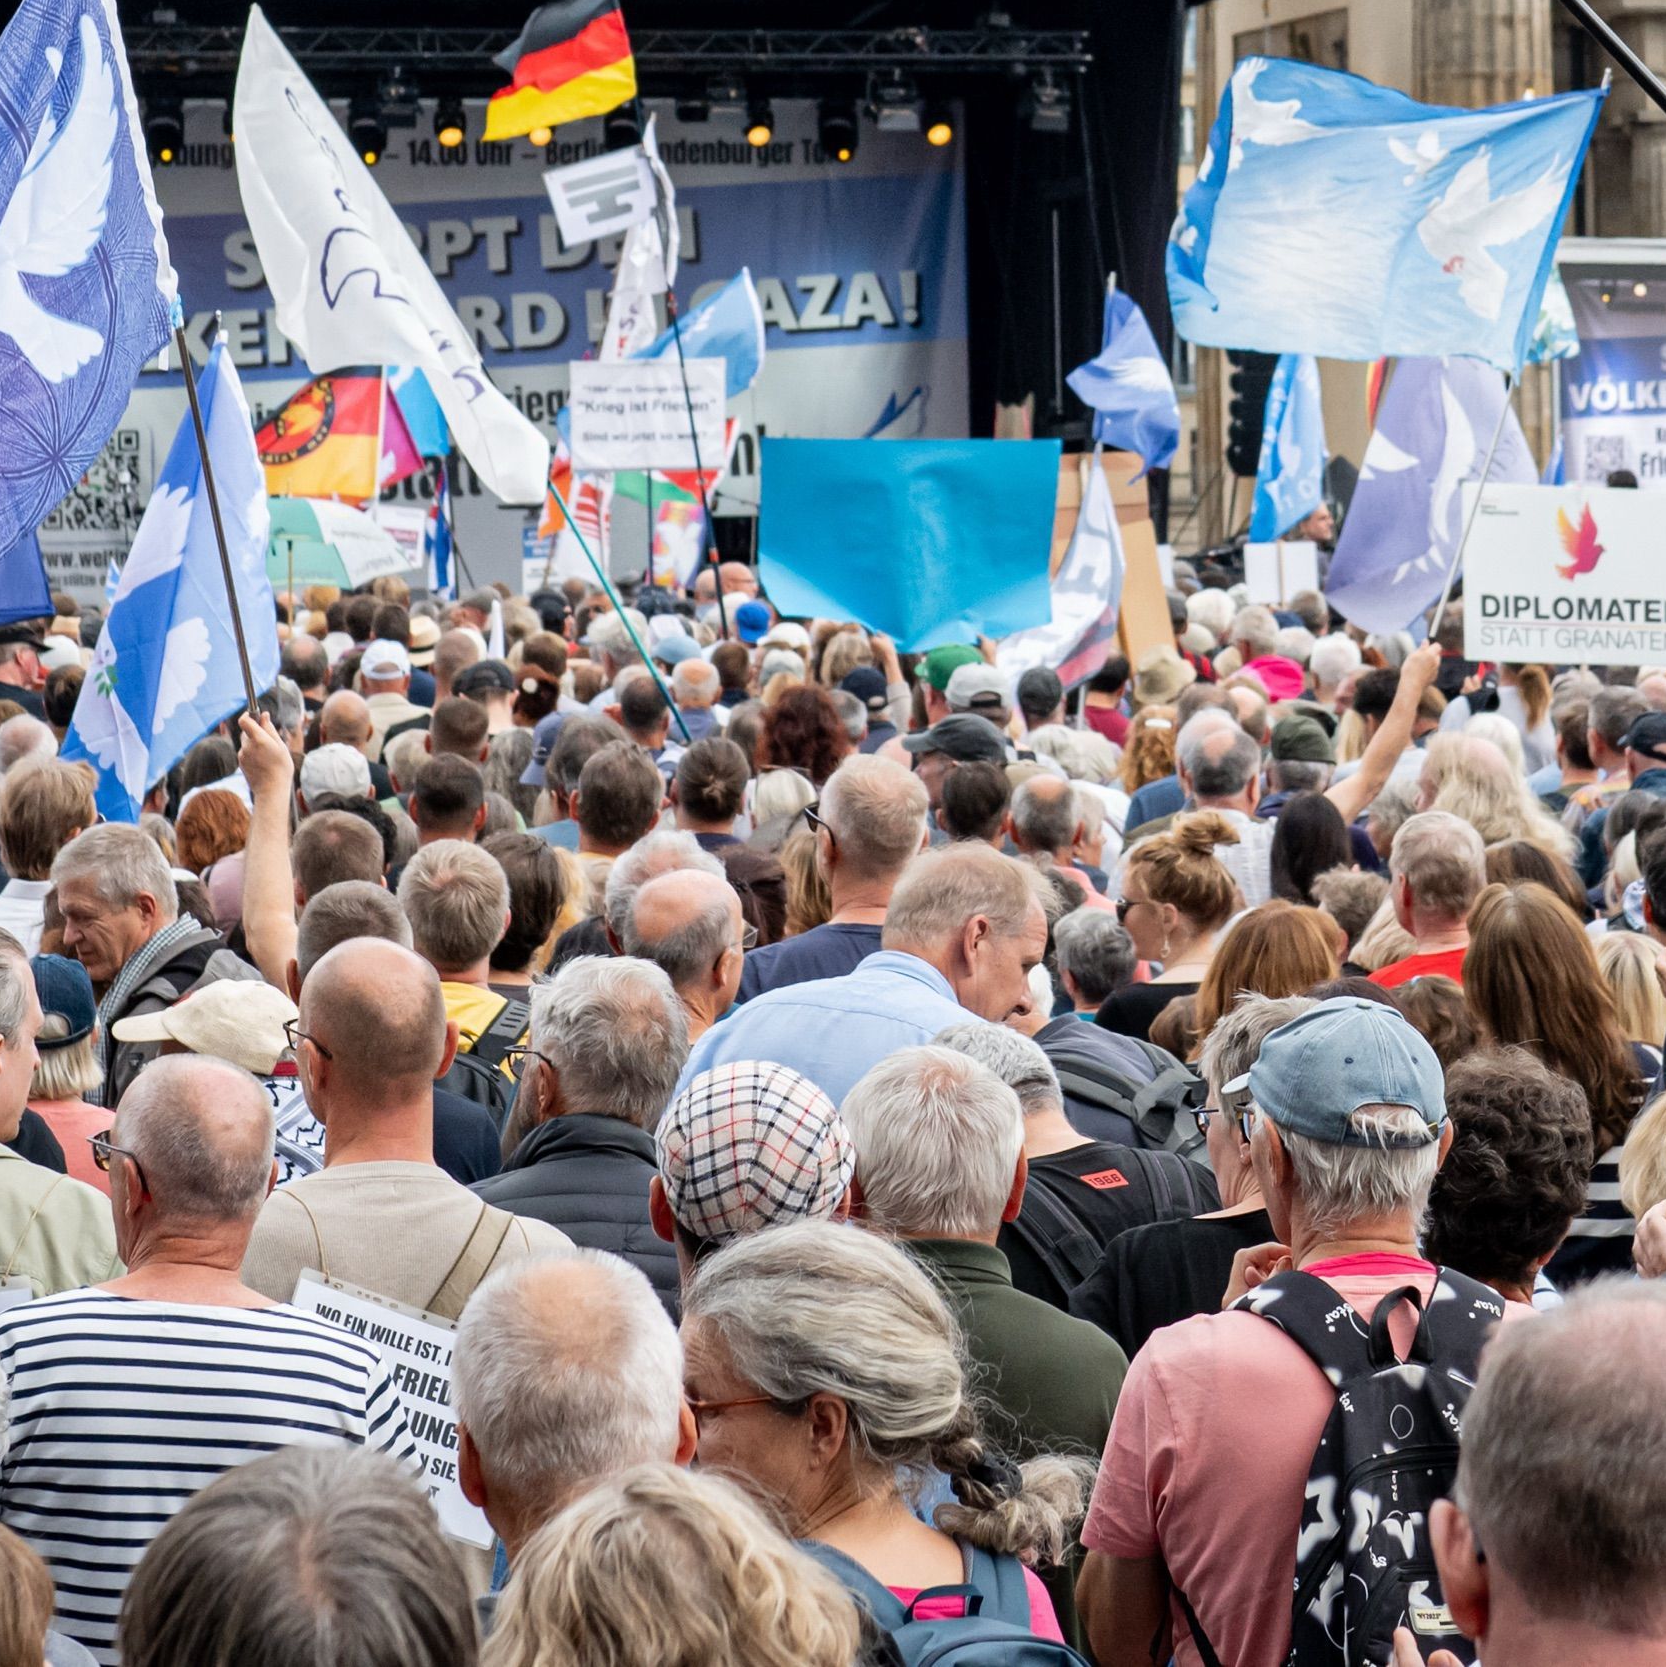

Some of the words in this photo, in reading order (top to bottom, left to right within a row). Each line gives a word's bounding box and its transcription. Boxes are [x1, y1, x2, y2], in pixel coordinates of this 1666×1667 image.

[476, 140, 514, 166] Uhr
[1480, 626, 1549, 649] STATT
[344, 1314, 369, 1336] EIN
[369, 1321, 415, 1354] WILLE
[415, 1340, 443, 1367] IST,
